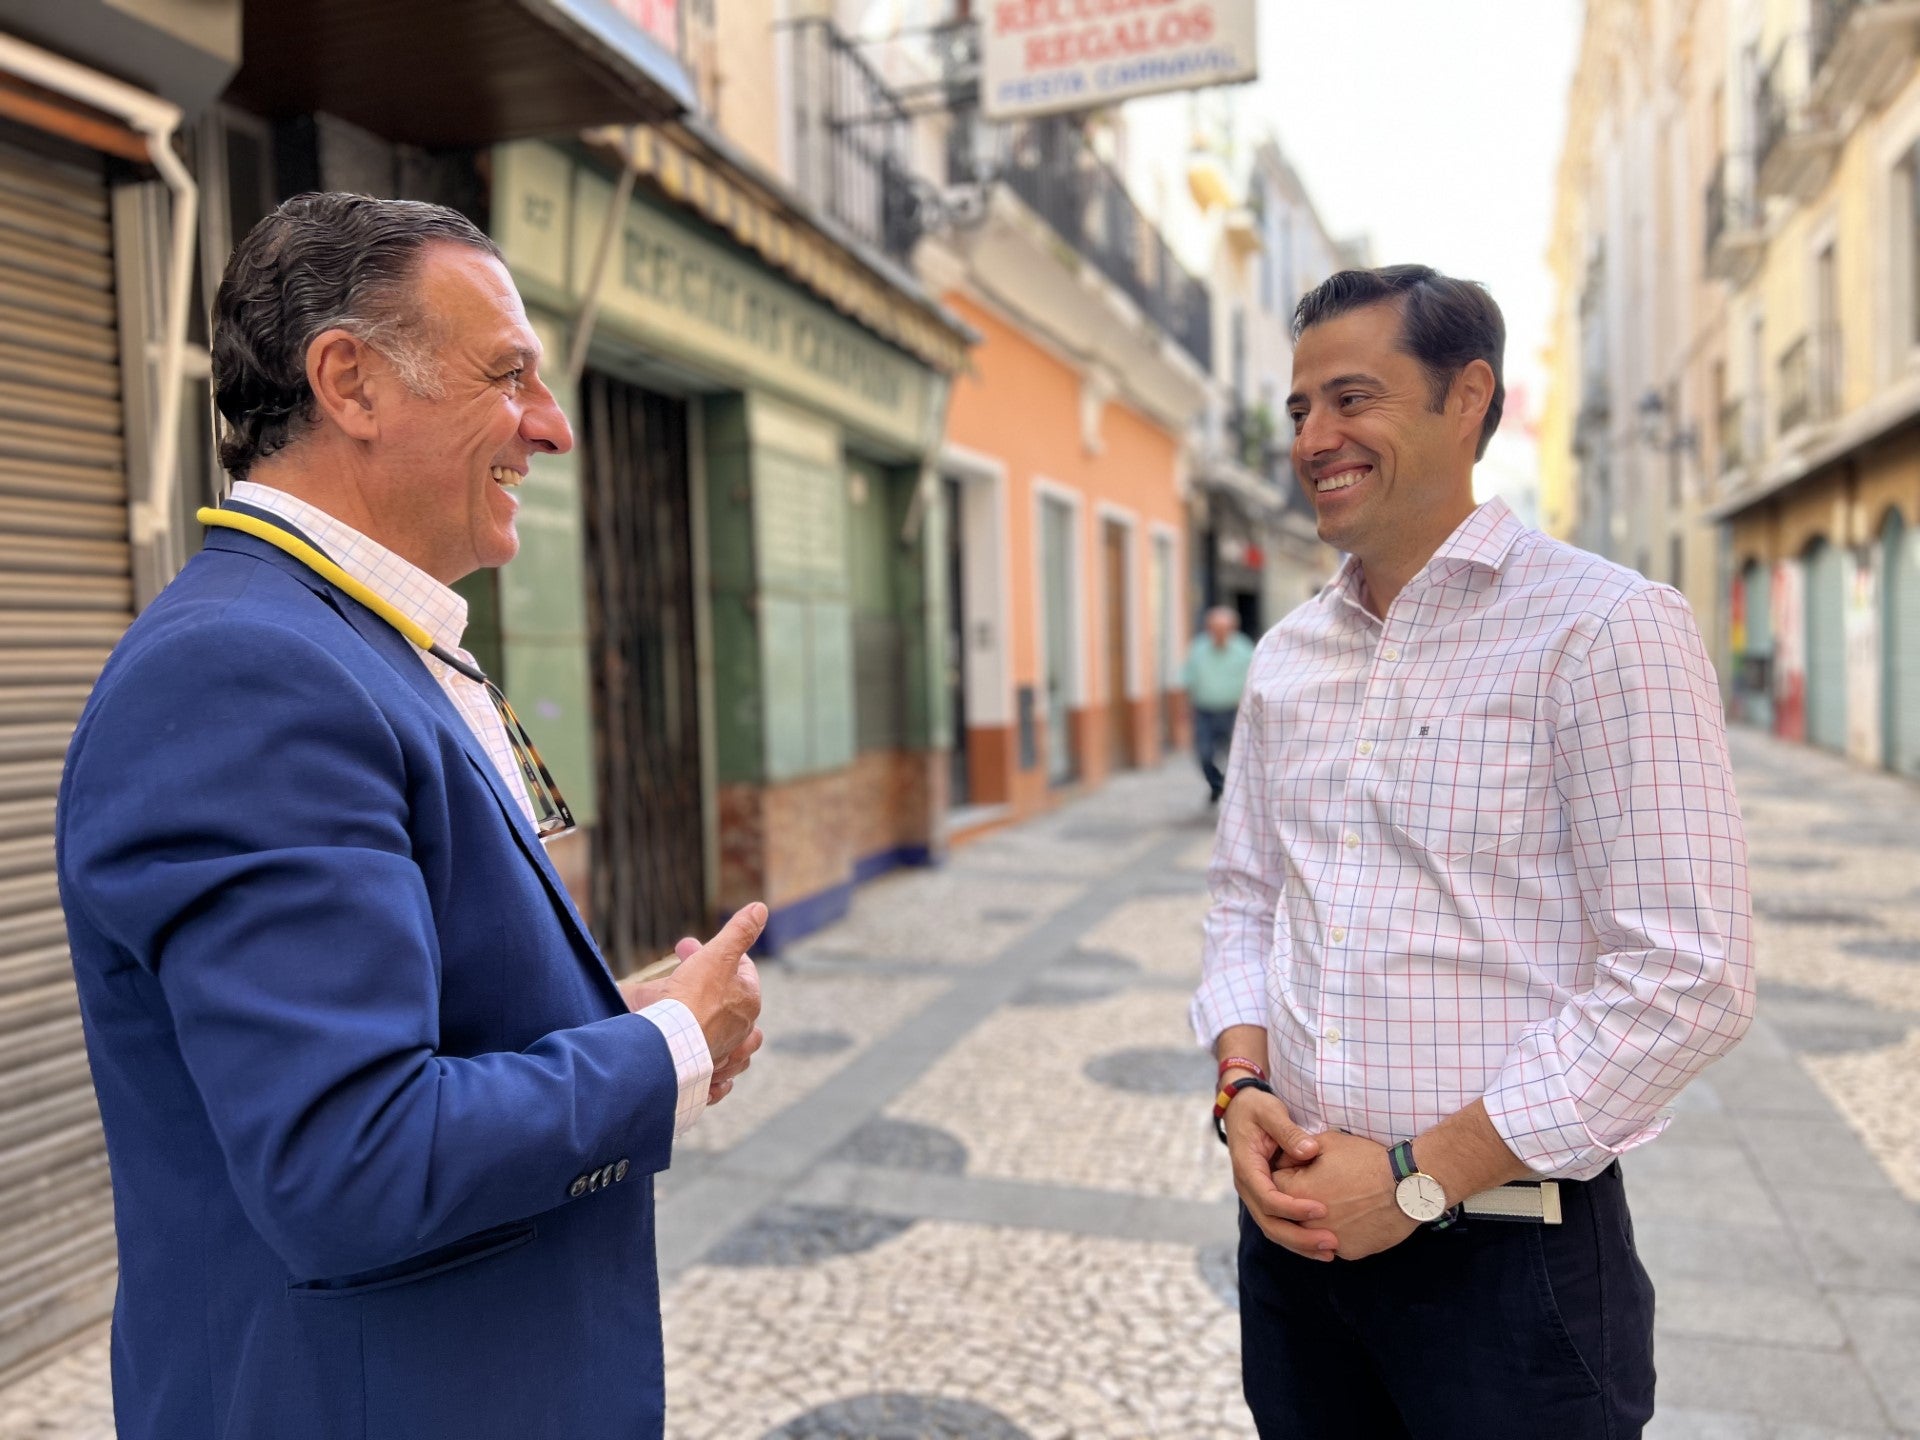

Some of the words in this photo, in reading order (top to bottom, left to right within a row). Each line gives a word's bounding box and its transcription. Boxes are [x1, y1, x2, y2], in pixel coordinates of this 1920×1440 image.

[1023, 7, 1215, 72] REGALOS
[999, 73, 1085, 99] FIESTA
[1095, 47, 1240, 89] CARNAVAL
